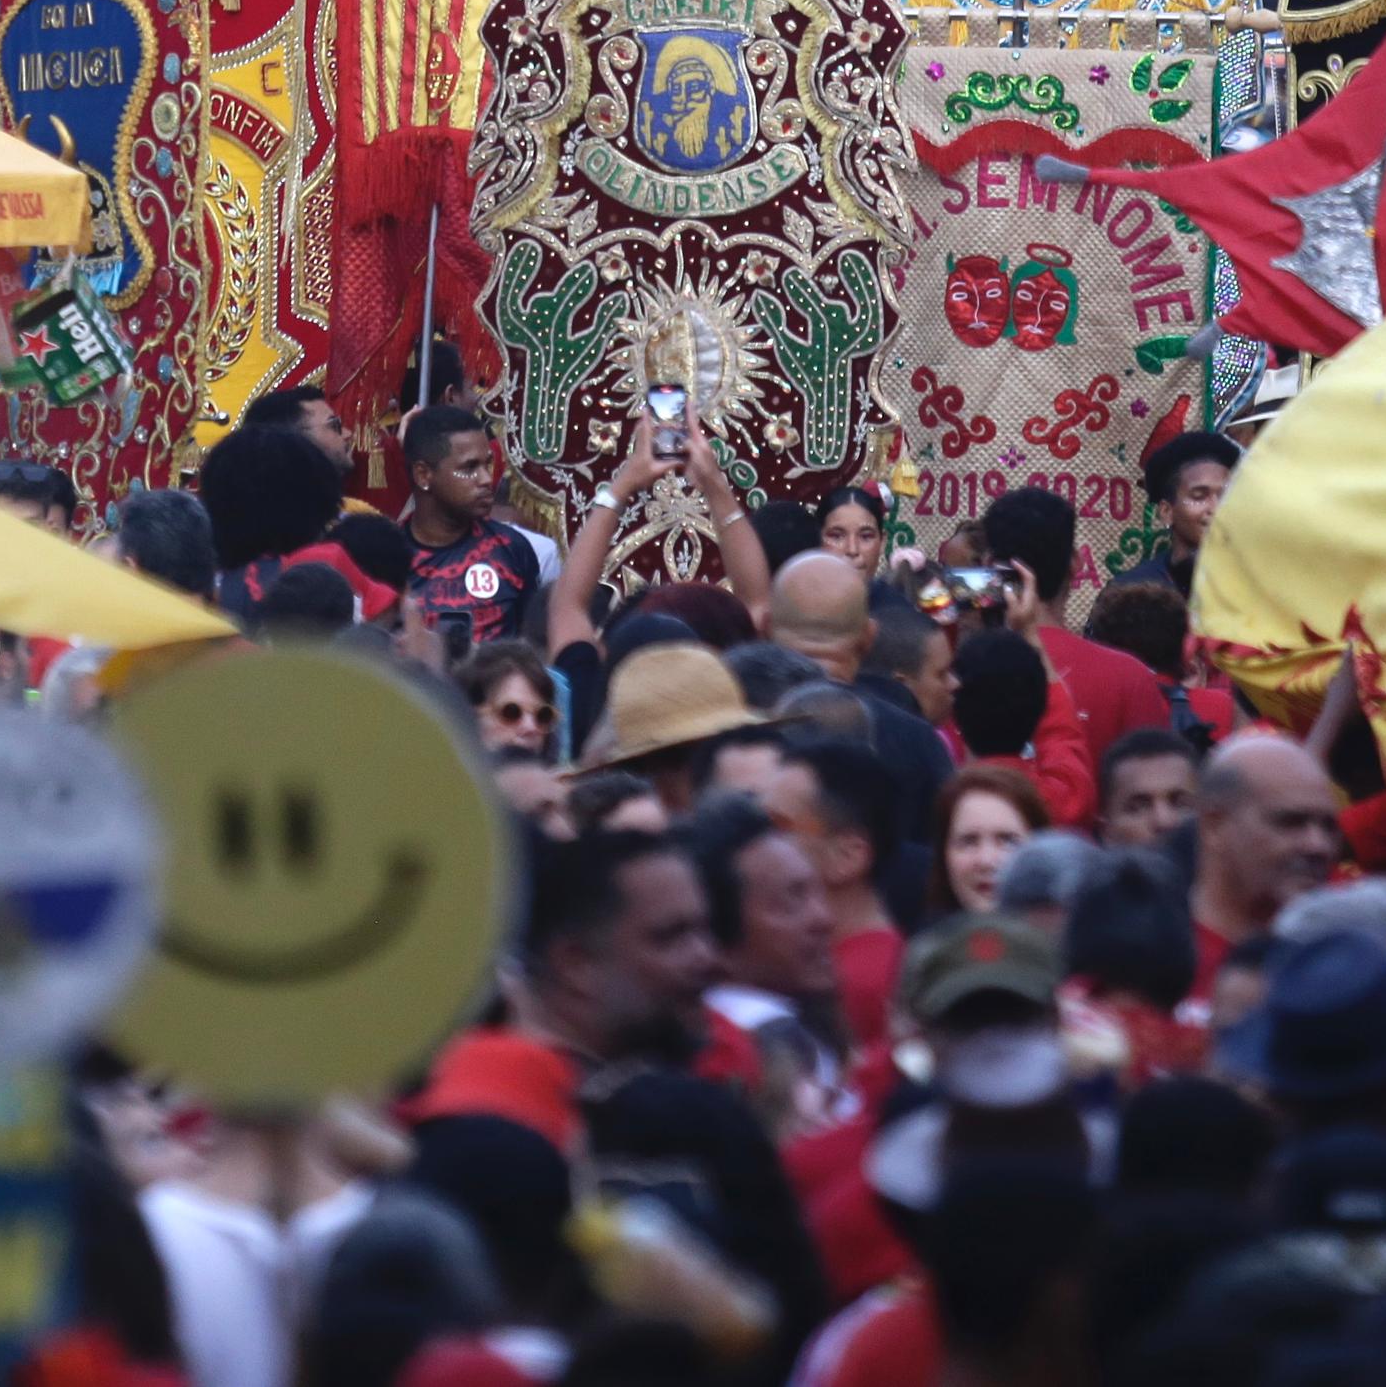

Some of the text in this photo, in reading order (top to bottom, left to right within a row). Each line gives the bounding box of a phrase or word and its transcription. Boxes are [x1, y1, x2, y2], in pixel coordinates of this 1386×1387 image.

[209, 93, 282, 158] ONFIM
[584, 147, 797, 212] OLINDENSE
[1074, 181, 1196, 332] NOME
[469, 569, 495, 593] 13
